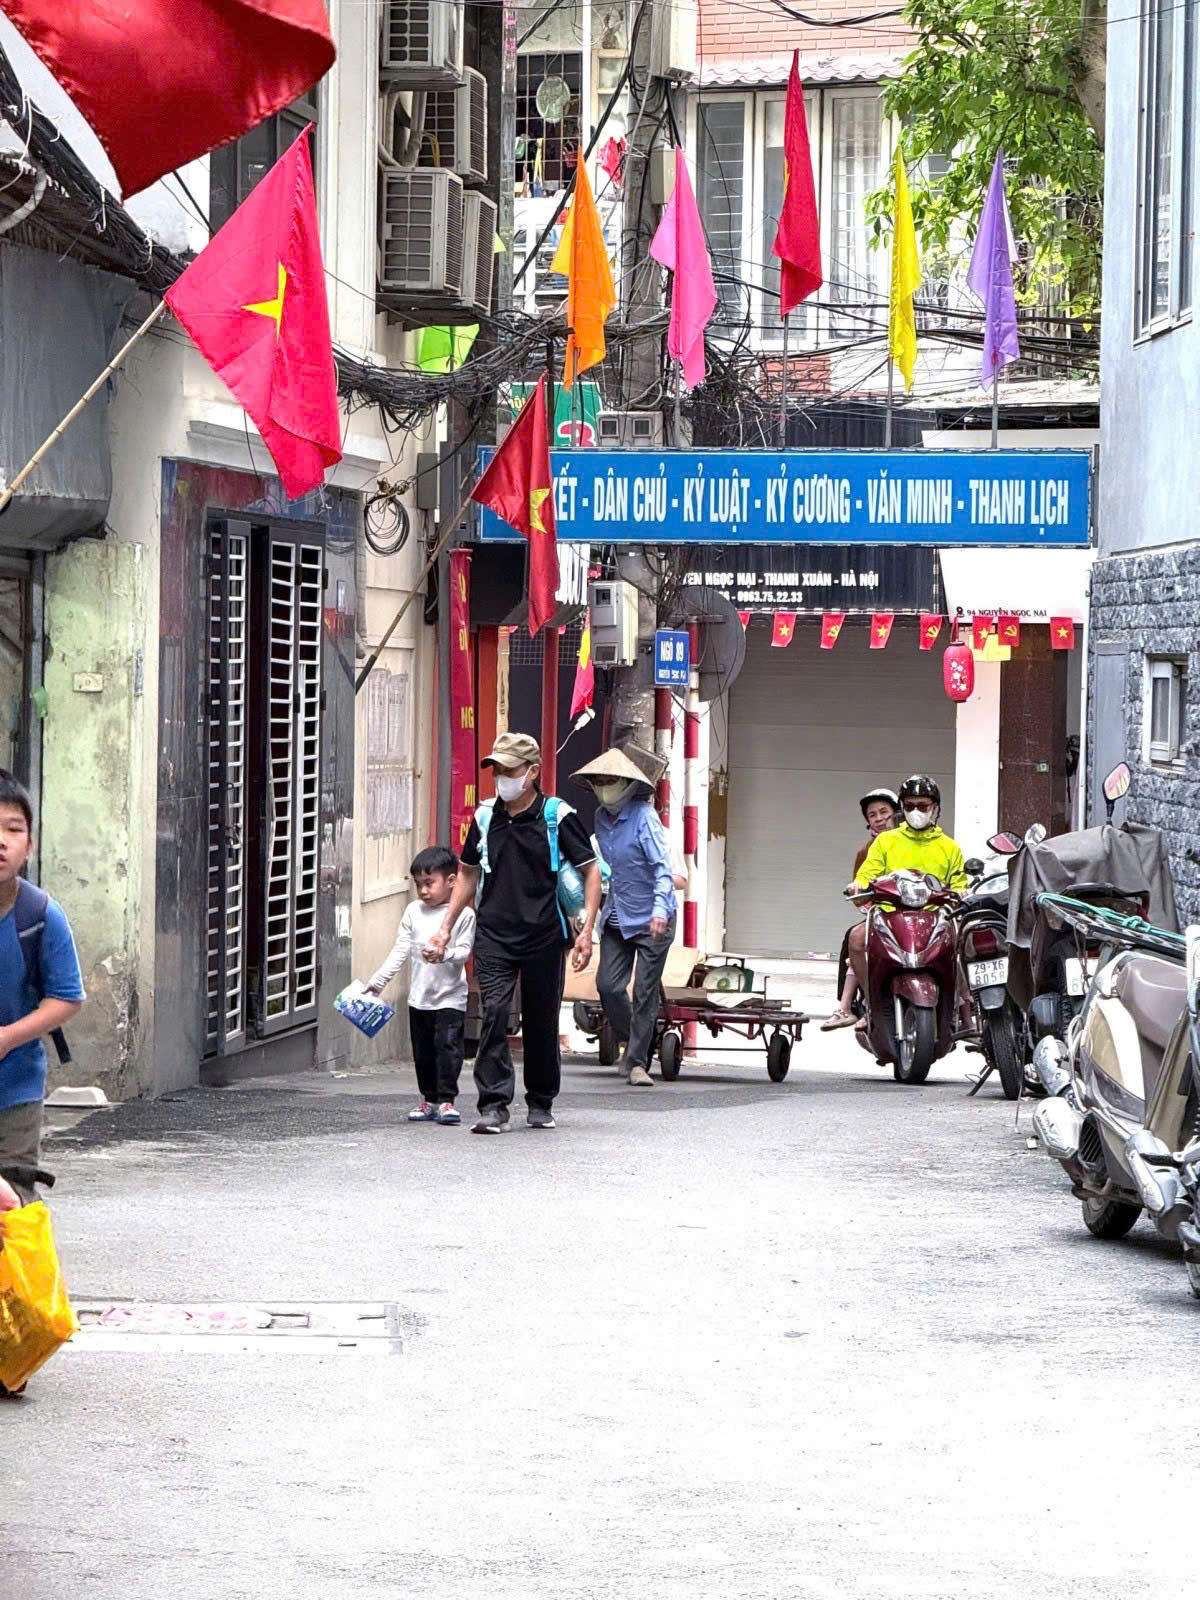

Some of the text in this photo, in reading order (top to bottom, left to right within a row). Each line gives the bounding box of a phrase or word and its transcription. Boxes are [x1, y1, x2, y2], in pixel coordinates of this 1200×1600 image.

[593, 467, 629, 522] DÂN
[634, 461, 666, 522] CHỦ
[683, 462, 705, 523] KỶ
[709, 469, 750, 533] LUẬT
[766, 462, 789, 523] KỶ
[793, 474, 851, 524] CƯƠNG
[867, 469, 902, 524] VĂN
[907, 480, 953, 524] MINH
[969, 479, 1026, 525] THANH
[1031, 479, 1069, 535] LỊCH
[705, 572, 734, 589] NGỌC
[737, 572, 757, 589] NẠI
[764, 572, 799, 587] THANH
[802, 570, 832, 587] XUÂN
[841, 569, 857, 587] HÀ
[860, 570, 880, 590] NỘI
[966, 609, 976, 617] 94
[978, 607, 1009, 617] NGUYỄN
[974, 959, 1005, 975] 29-X6
